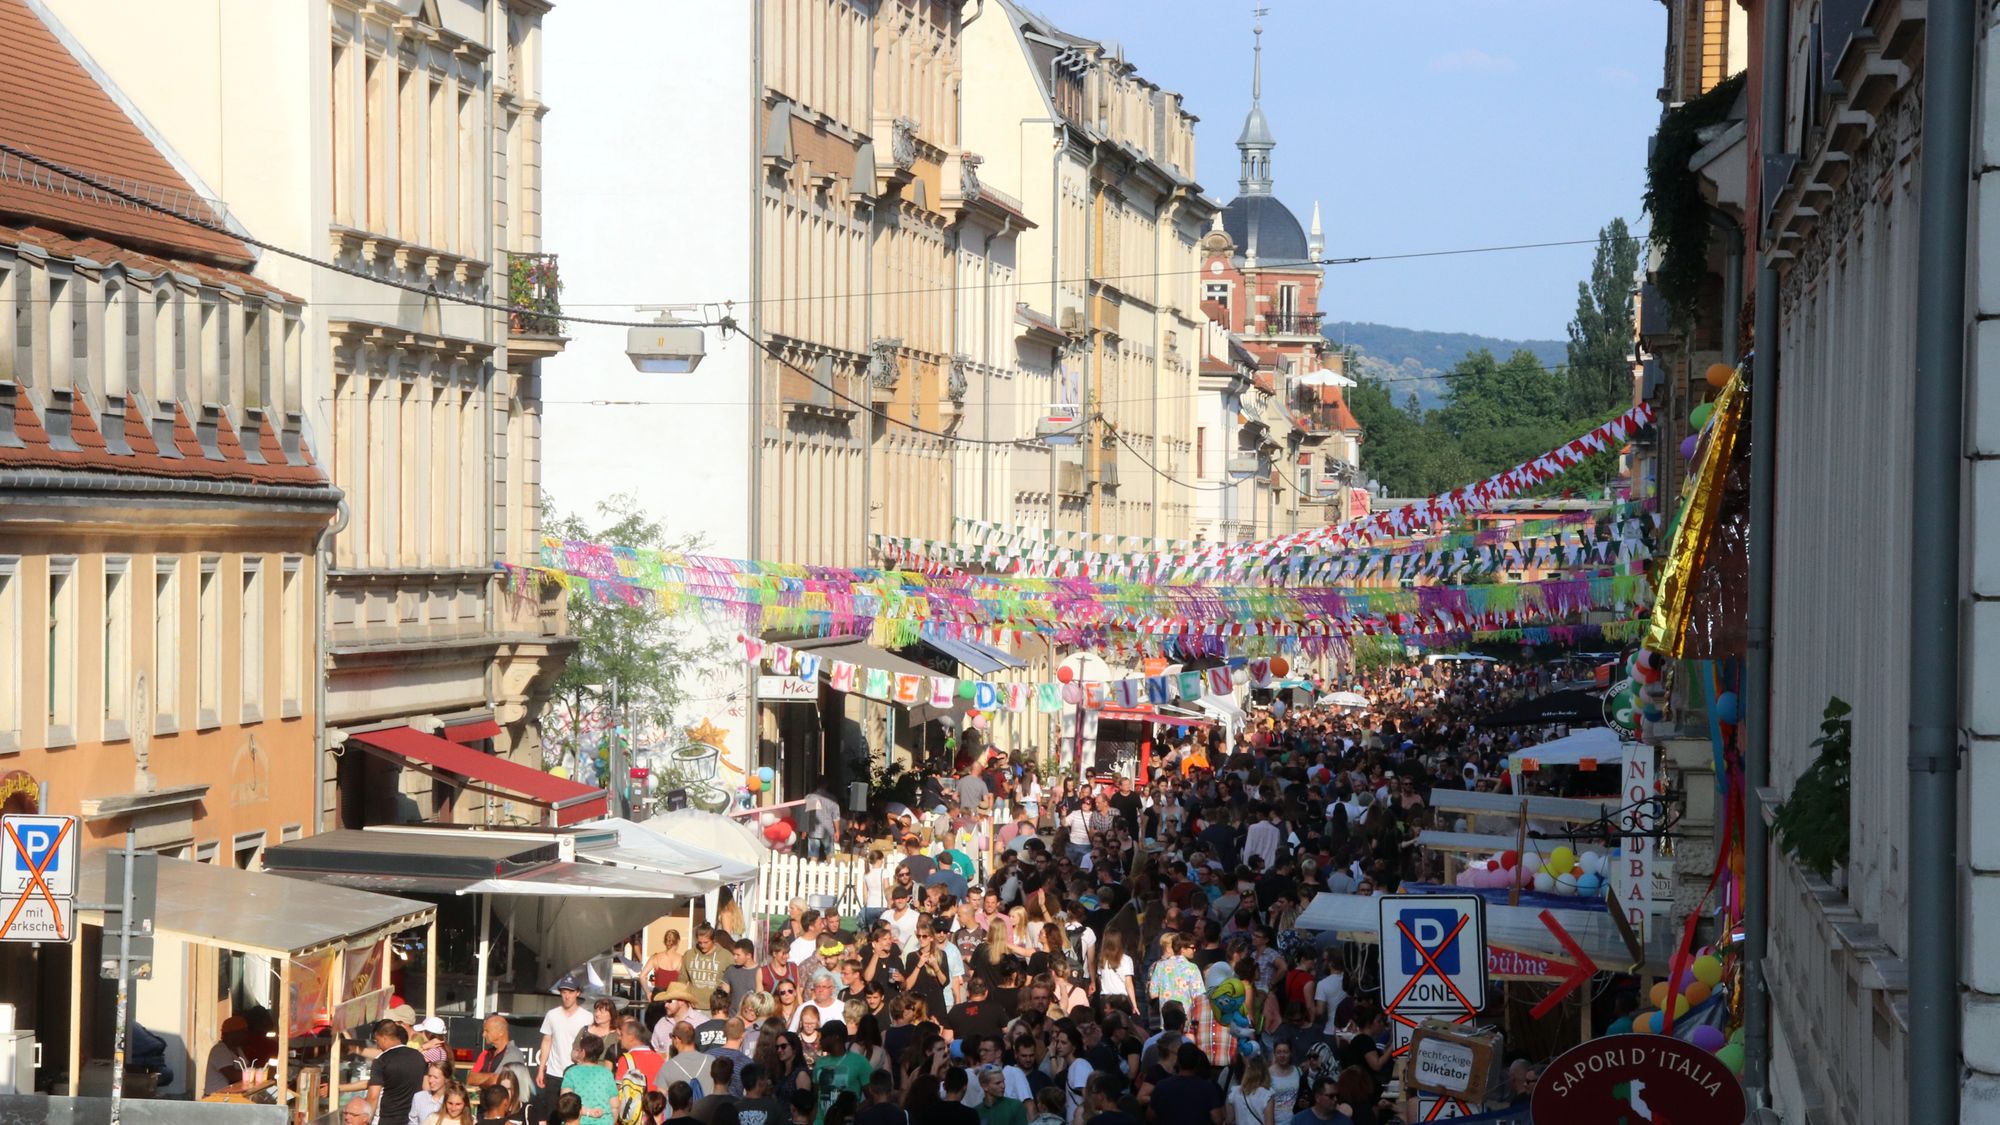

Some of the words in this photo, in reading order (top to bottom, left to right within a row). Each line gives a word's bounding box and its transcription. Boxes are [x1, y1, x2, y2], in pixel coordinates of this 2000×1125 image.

[27, 831, 49, 862] P
[1628, 761, 1647, 926] NORDBAD
[26, 907, 43, 918] mit
[1414, 918, 1445, 966] P
[1418, 1050, 1472, 1068] rechteckige
[1422, 1062, 1468, 1080] Diktator
[1552, 1049, 1626, 1097] SAPORI
